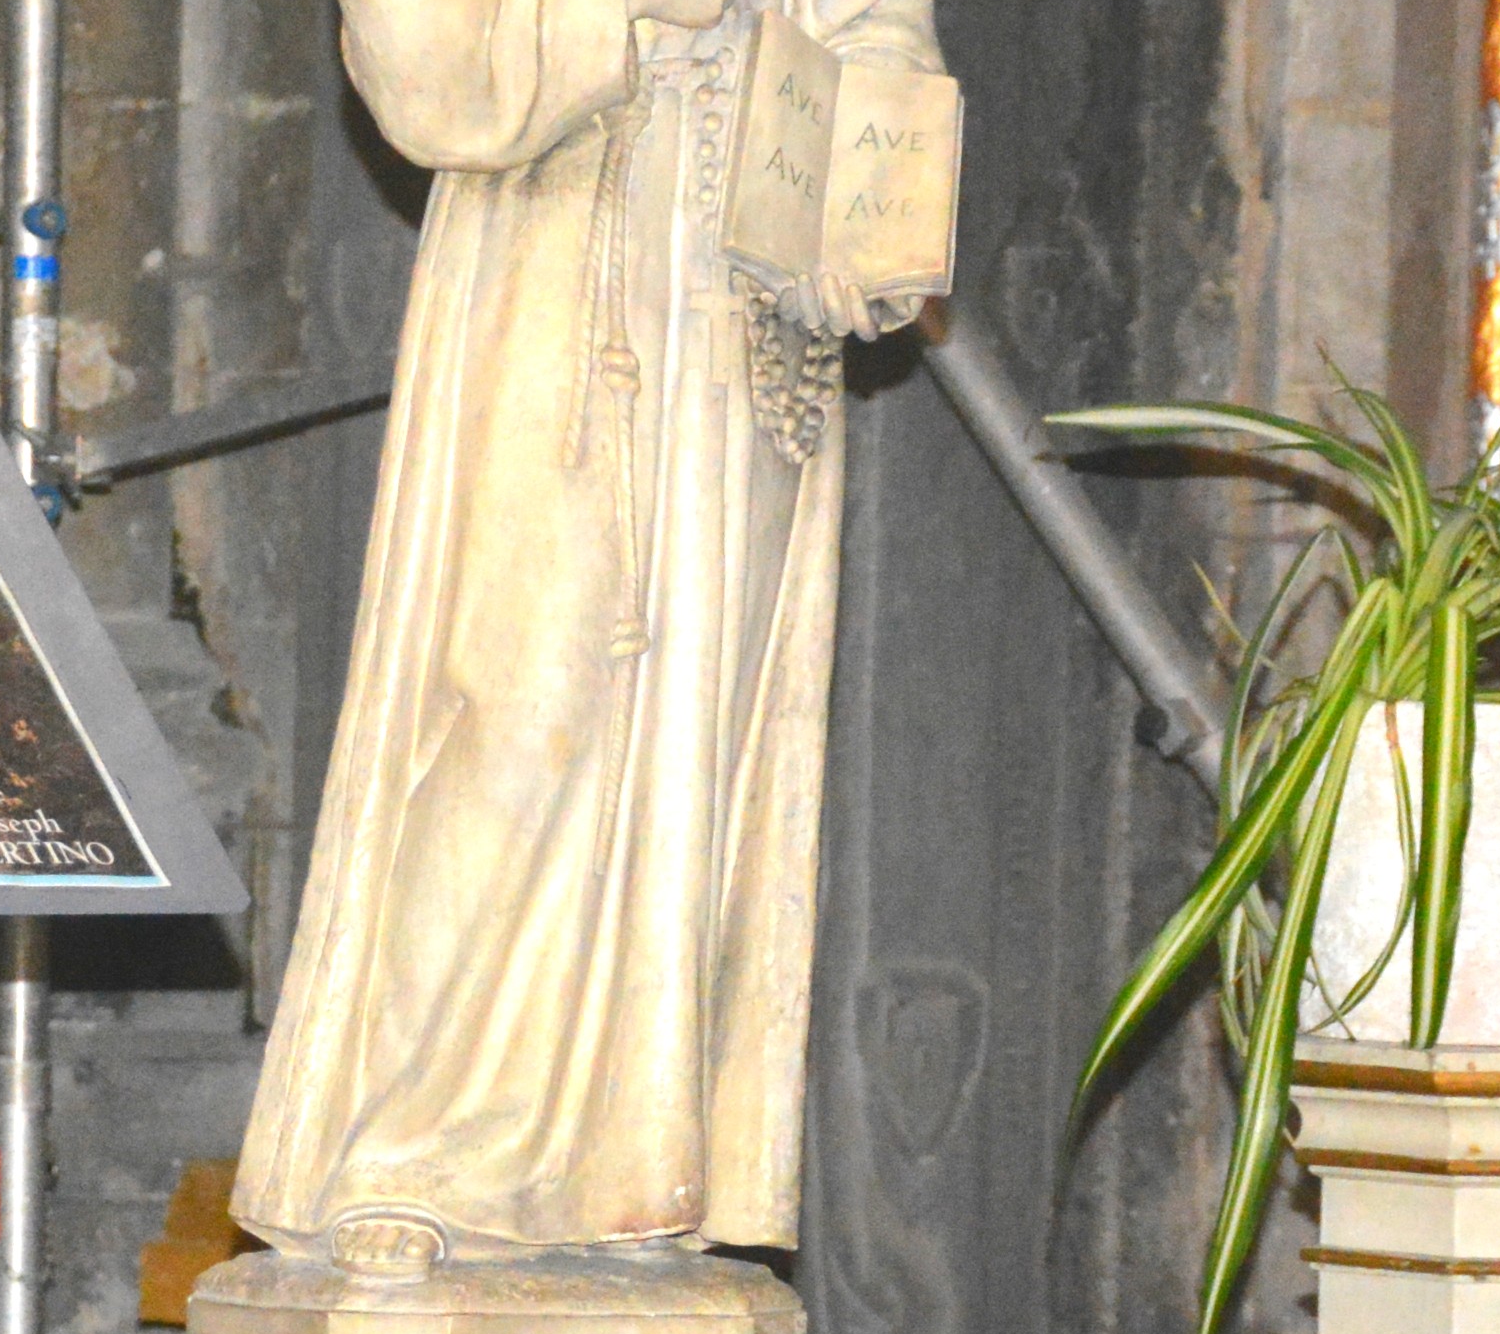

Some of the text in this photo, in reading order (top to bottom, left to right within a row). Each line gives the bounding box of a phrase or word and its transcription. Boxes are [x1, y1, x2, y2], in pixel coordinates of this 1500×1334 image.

[777, 72, 823, 126] AVE
[855, 122, 926, 153] AVE
[765, 146, 817, 199] AVE
[844, 191, 914, 222] AVE
